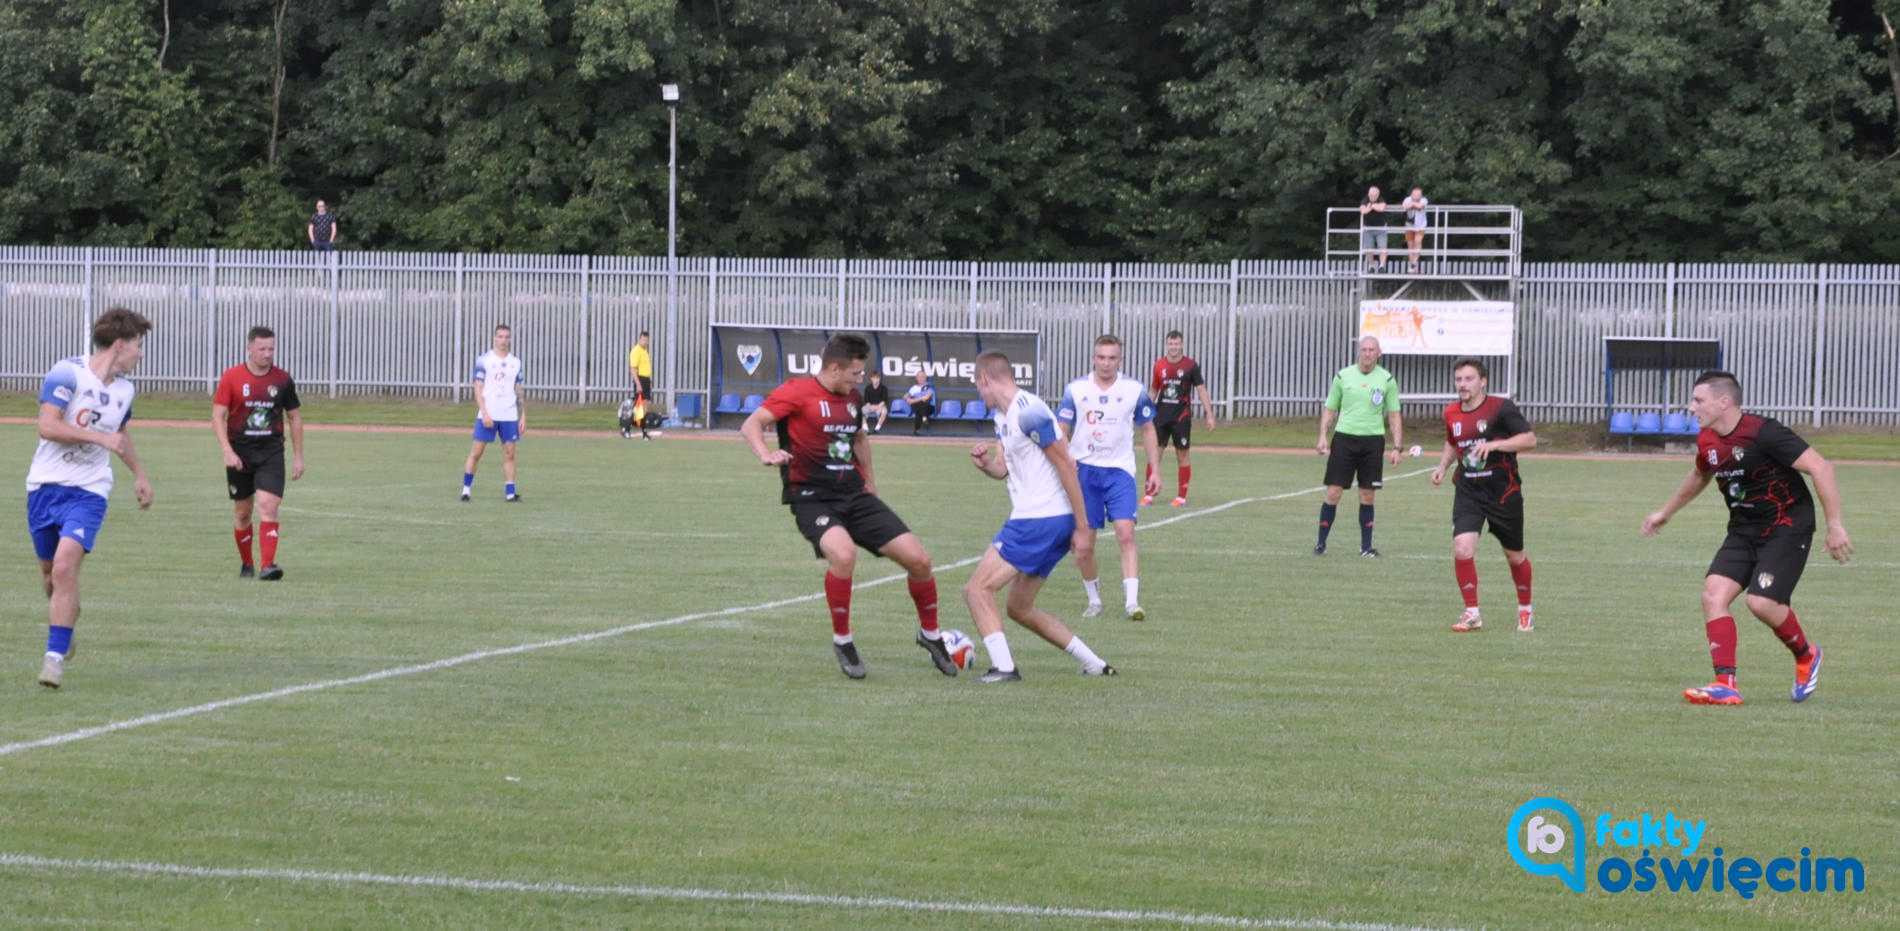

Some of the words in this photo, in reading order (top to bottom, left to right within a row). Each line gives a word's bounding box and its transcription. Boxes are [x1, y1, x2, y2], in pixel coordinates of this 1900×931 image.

[882, 355, 1033, 384] Oświęm
[242, 383, 250, 397] 6
[819, 400, 831, 417] 11
